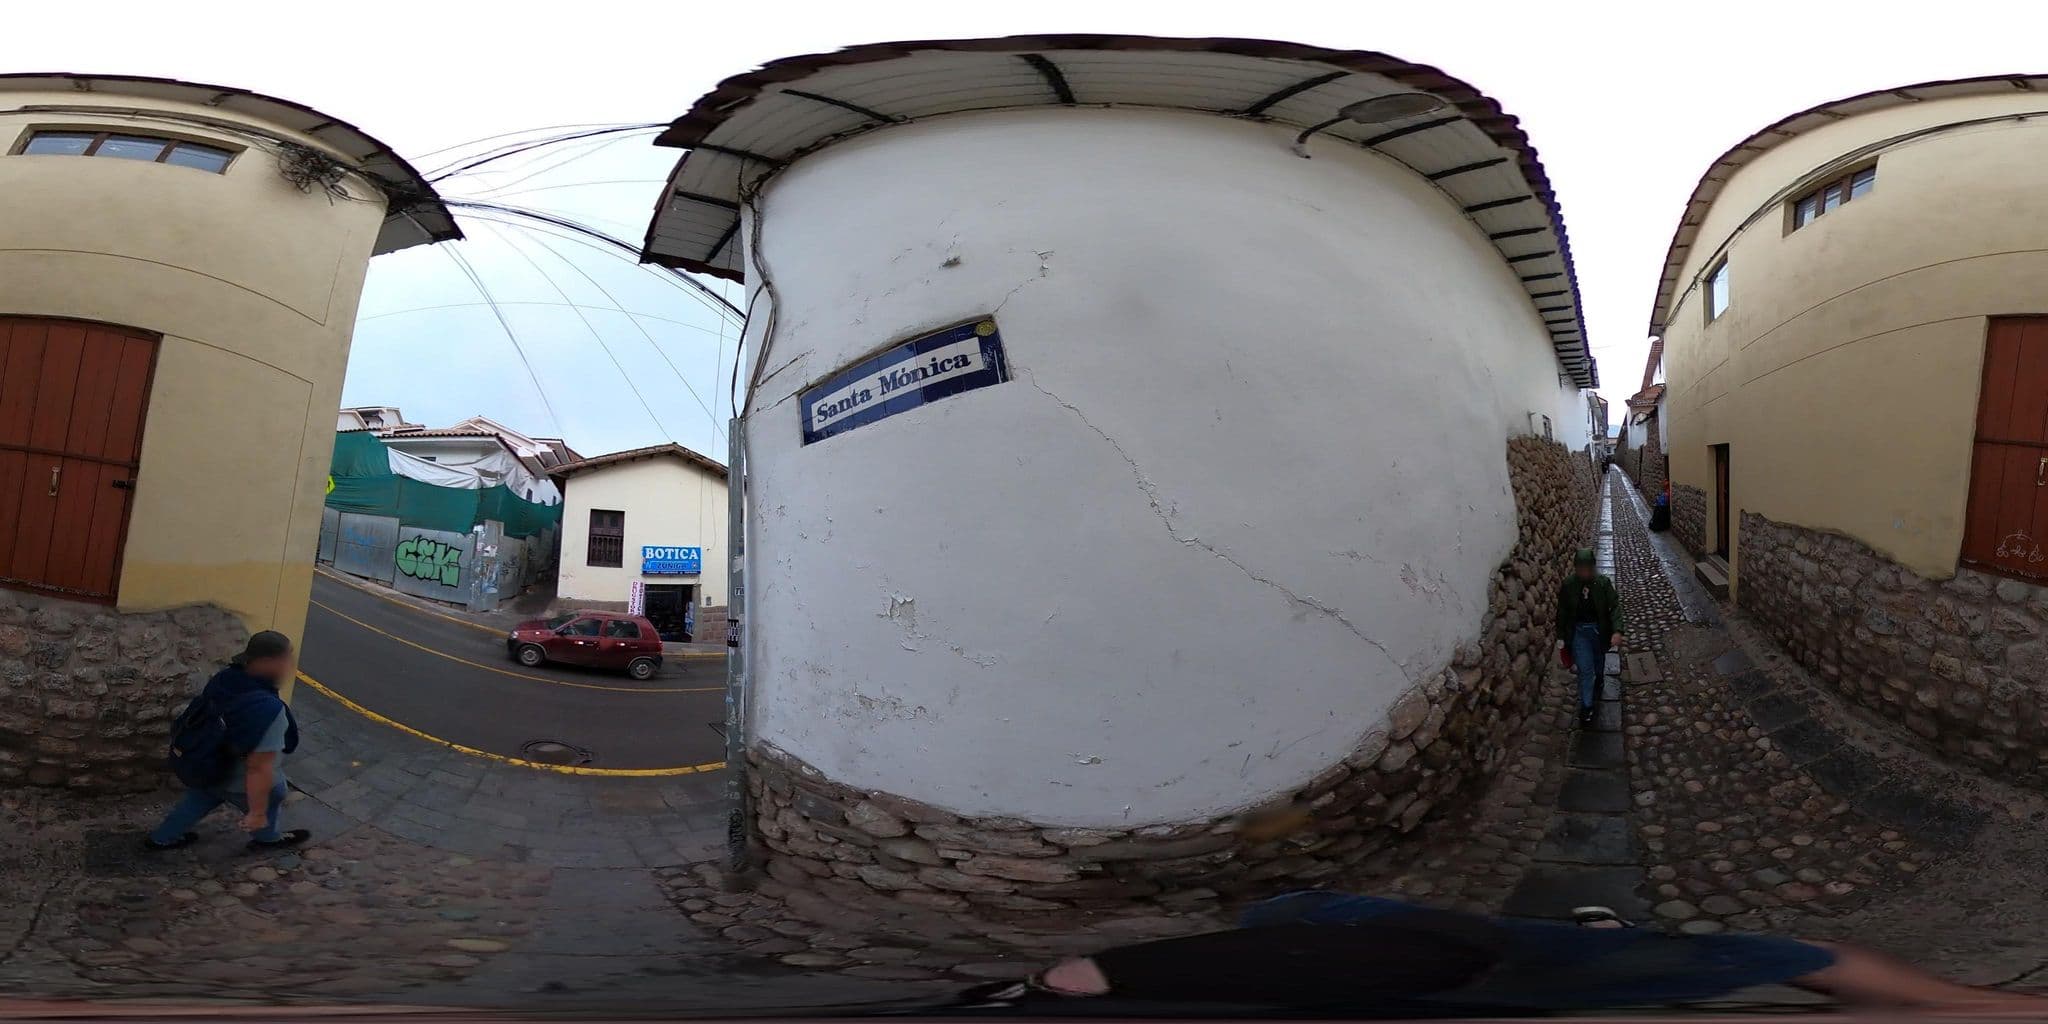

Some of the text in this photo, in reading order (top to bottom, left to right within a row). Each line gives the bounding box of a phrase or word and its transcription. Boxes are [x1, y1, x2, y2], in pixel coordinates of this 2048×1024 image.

[816, 353, 972, 424] Santa Mónica
[645, 547, 699, 560] BOTICA
